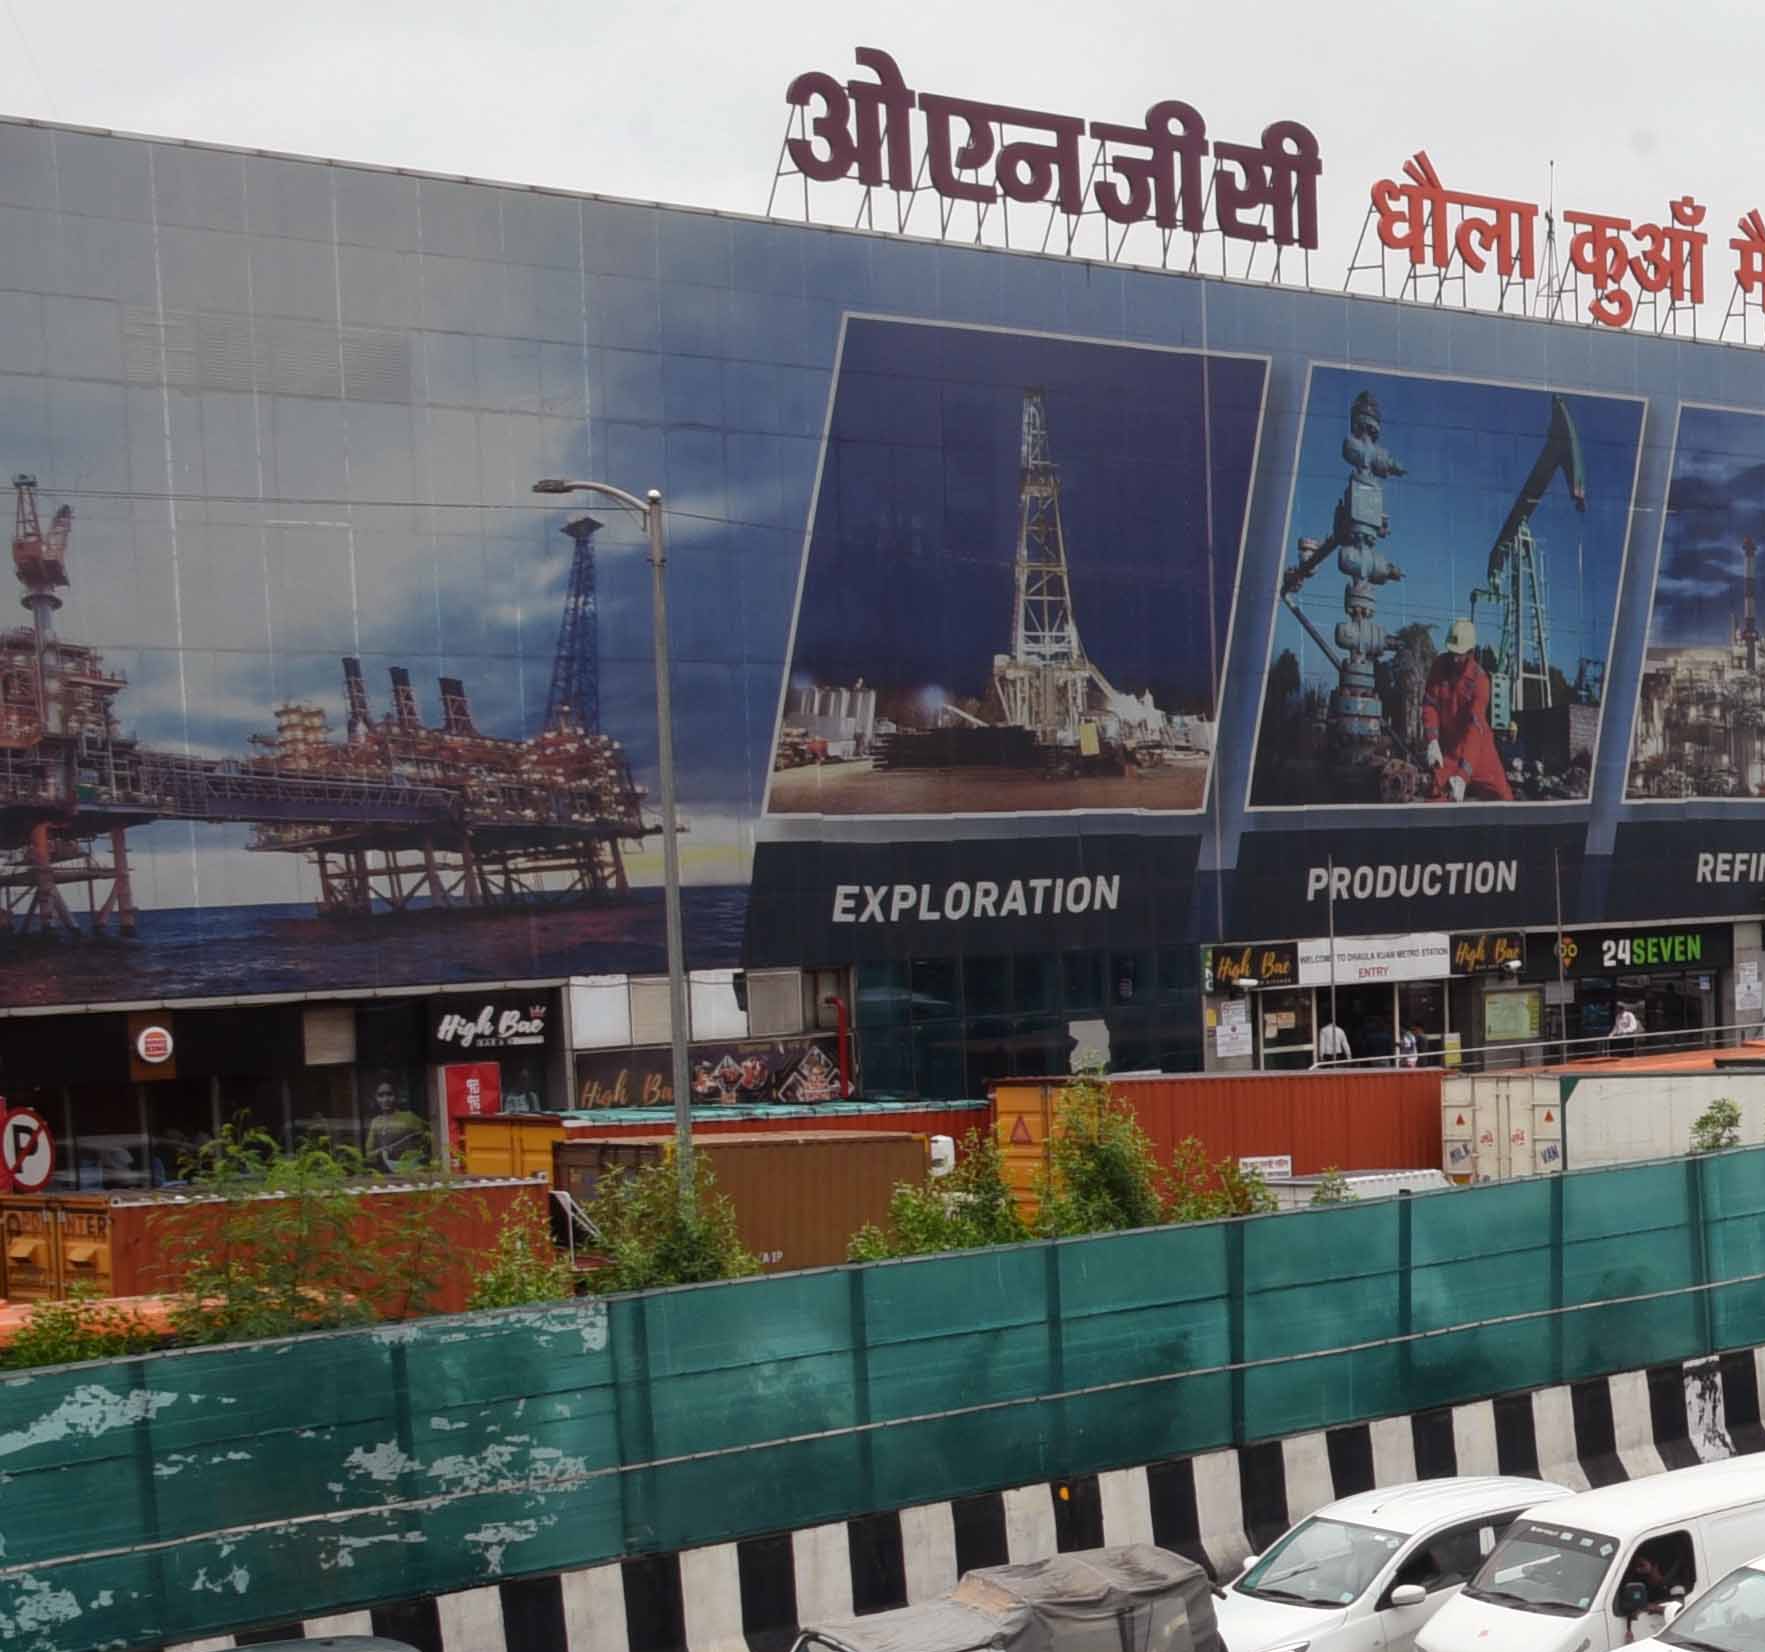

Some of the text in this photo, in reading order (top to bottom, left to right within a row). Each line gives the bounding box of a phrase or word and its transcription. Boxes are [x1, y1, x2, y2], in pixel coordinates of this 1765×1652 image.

[785, 47, 1322, 250] ओएनजीसी
[1371, 150, 1539, 283] धौला
[1563, 196, 1707, 328] कुआँ
[832, 874, 1120, 923] EXPLORATION
[1307, 859, 1518, 902] PRODUCTION
[1358, 966, 1388, 978] ENTRY
[1602, 934, 1702, 967] 24SEVEN
[437, 1005, 494, 1048] High
